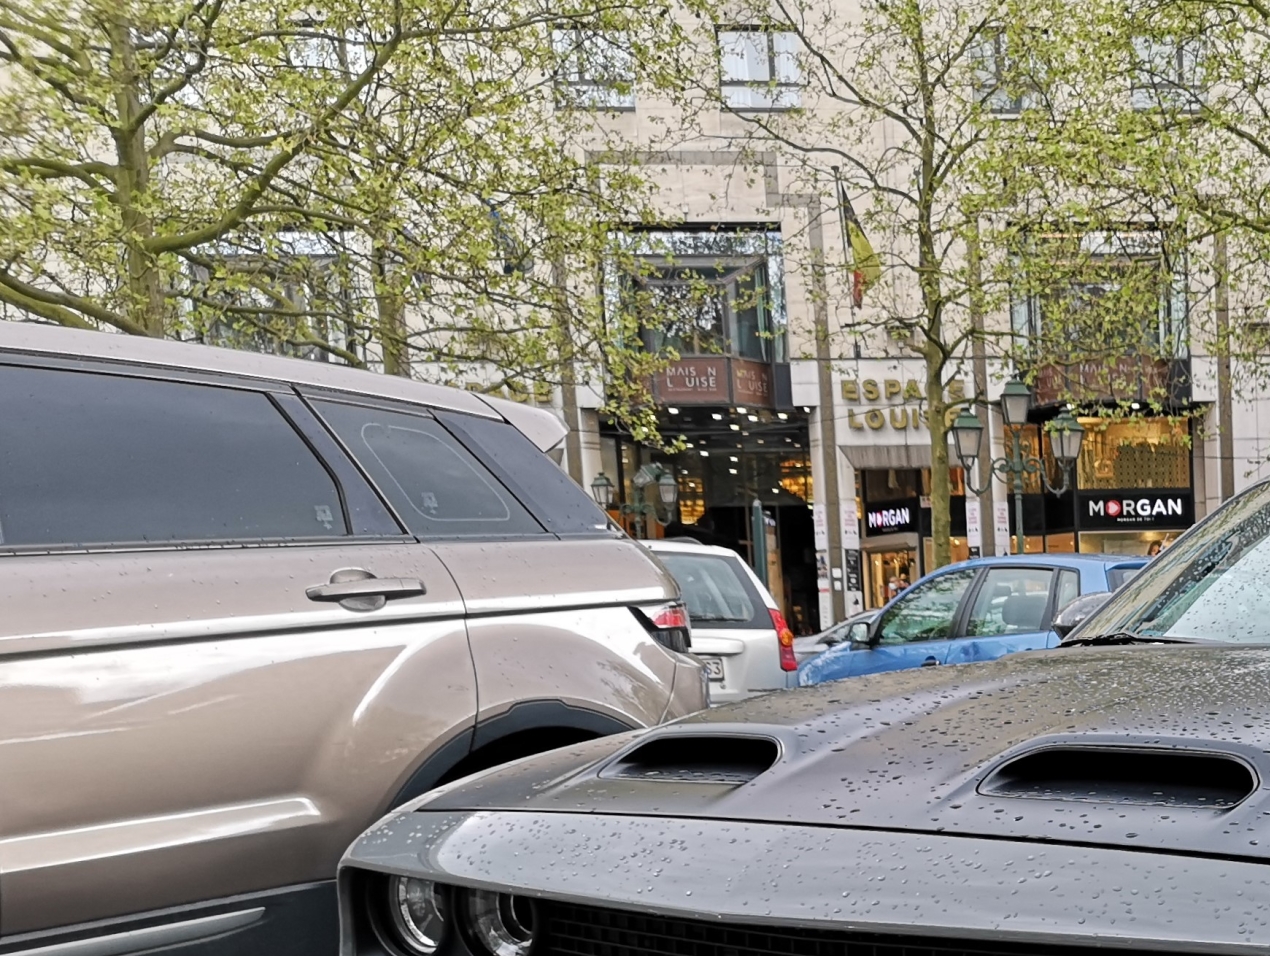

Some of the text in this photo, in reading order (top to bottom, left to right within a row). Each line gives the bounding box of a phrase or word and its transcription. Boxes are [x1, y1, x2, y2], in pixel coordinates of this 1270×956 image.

[666, 366, 717, 377] MAISN
[666, 376, 717, 388] LUISE
[841, 379, 966, 401] ESPAE
[847, 408, 964, 430] LOUIE
[867, 507, 910, 528] MORGAN
[1088, 498, 1183, 517] MORGAN
